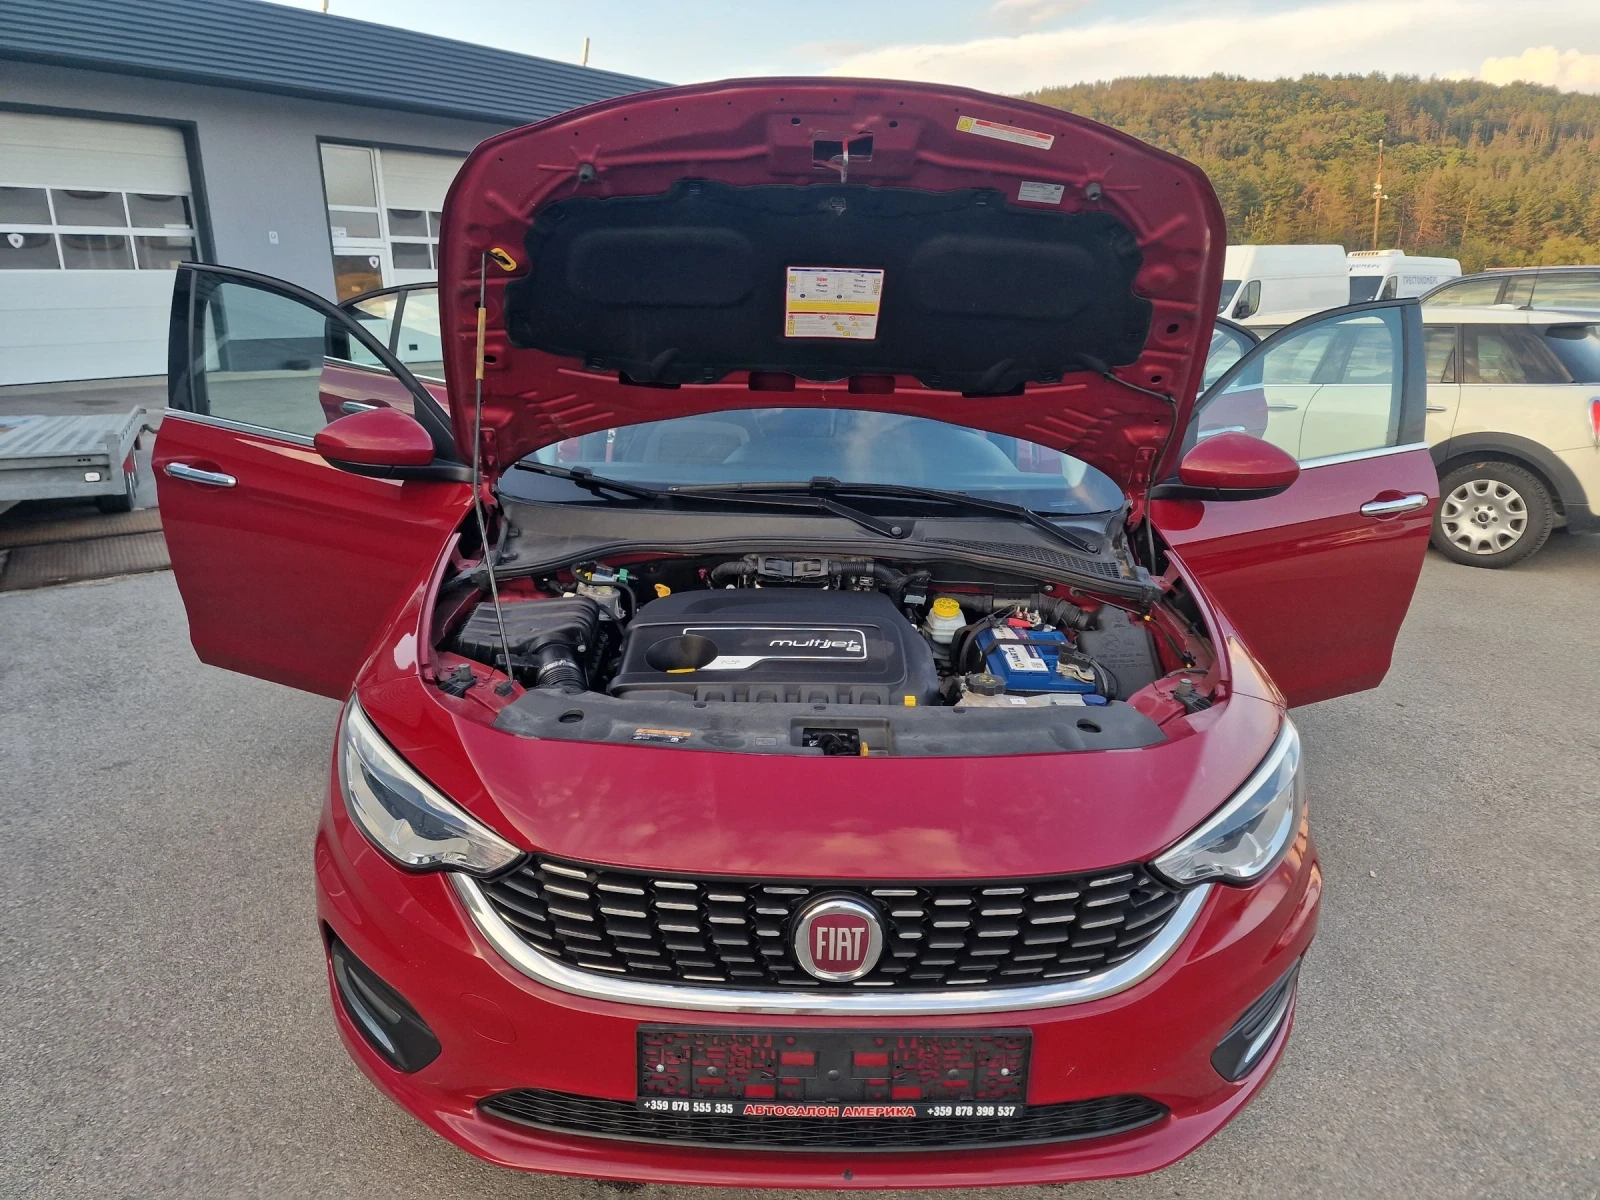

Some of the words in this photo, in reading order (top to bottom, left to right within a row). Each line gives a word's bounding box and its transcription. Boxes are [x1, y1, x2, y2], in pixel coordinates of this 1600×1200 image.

[769, 639, 858, 649] multijet
[1007, 647, 1021, 663] VARTA
[816, 926, 865, 960] FIAT
[643, 1099, 669, 1111] +359
[672, 1101, 690, 1112] 878
[693, 1102, 712, 1113] 555
[715, 1103, 734, 1114] 335
[743, 1104, 840, 1117] АВТОСАЛОН
[842, 1105, 917, 1118] АМЕРИКА
[927, 1105, 953, 1117] +359
[955, 1105, 973, 1117] 878
[976, 1105, 995, 1117] 398
[997, 1105, 1016, 1117] 537
